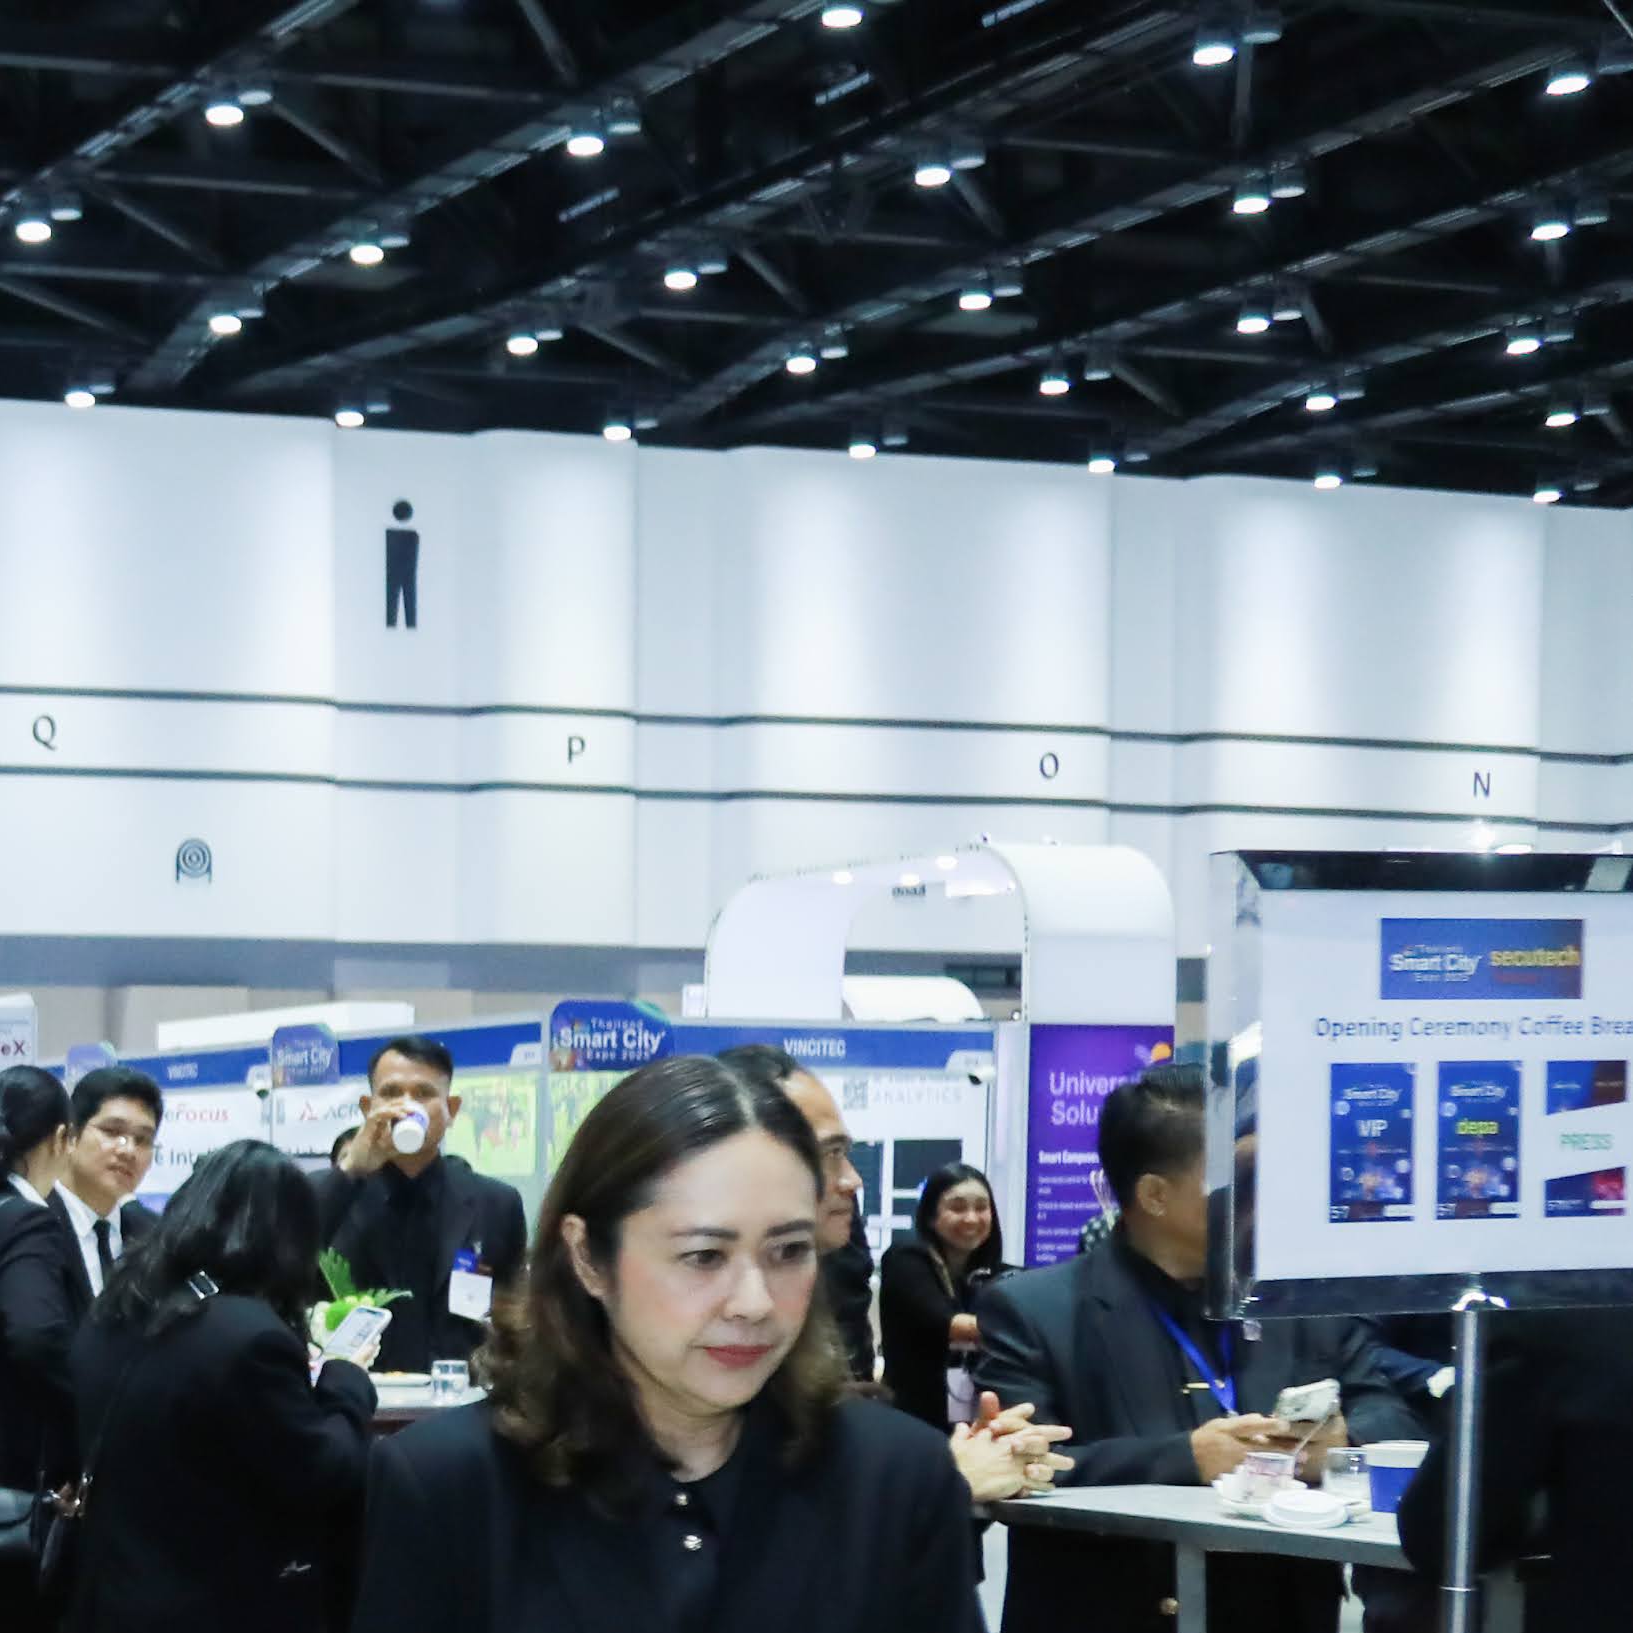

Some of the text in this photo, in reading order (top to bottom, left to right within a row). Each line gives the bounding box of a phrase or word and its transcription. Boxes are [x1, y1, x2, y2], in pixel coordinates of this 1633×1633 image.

[32, 714, 58, 750] Q
[567, 735, 586, 763] P
[1038, 751, 1060, 779] O
[1472, 770, 1492, 798] N
[1388, 953, 1441, 972] Smart
[561, 1028, 662, 1055] Smart City
[1314, 1015, 1633, 1042] Opening Ceremony Coffee Brea
[1048, 1071, 1127, 1098] Univer
[1051, 1099, 1100, 1127] Solu
[1356, 1119, 1388, 1138] VIP
